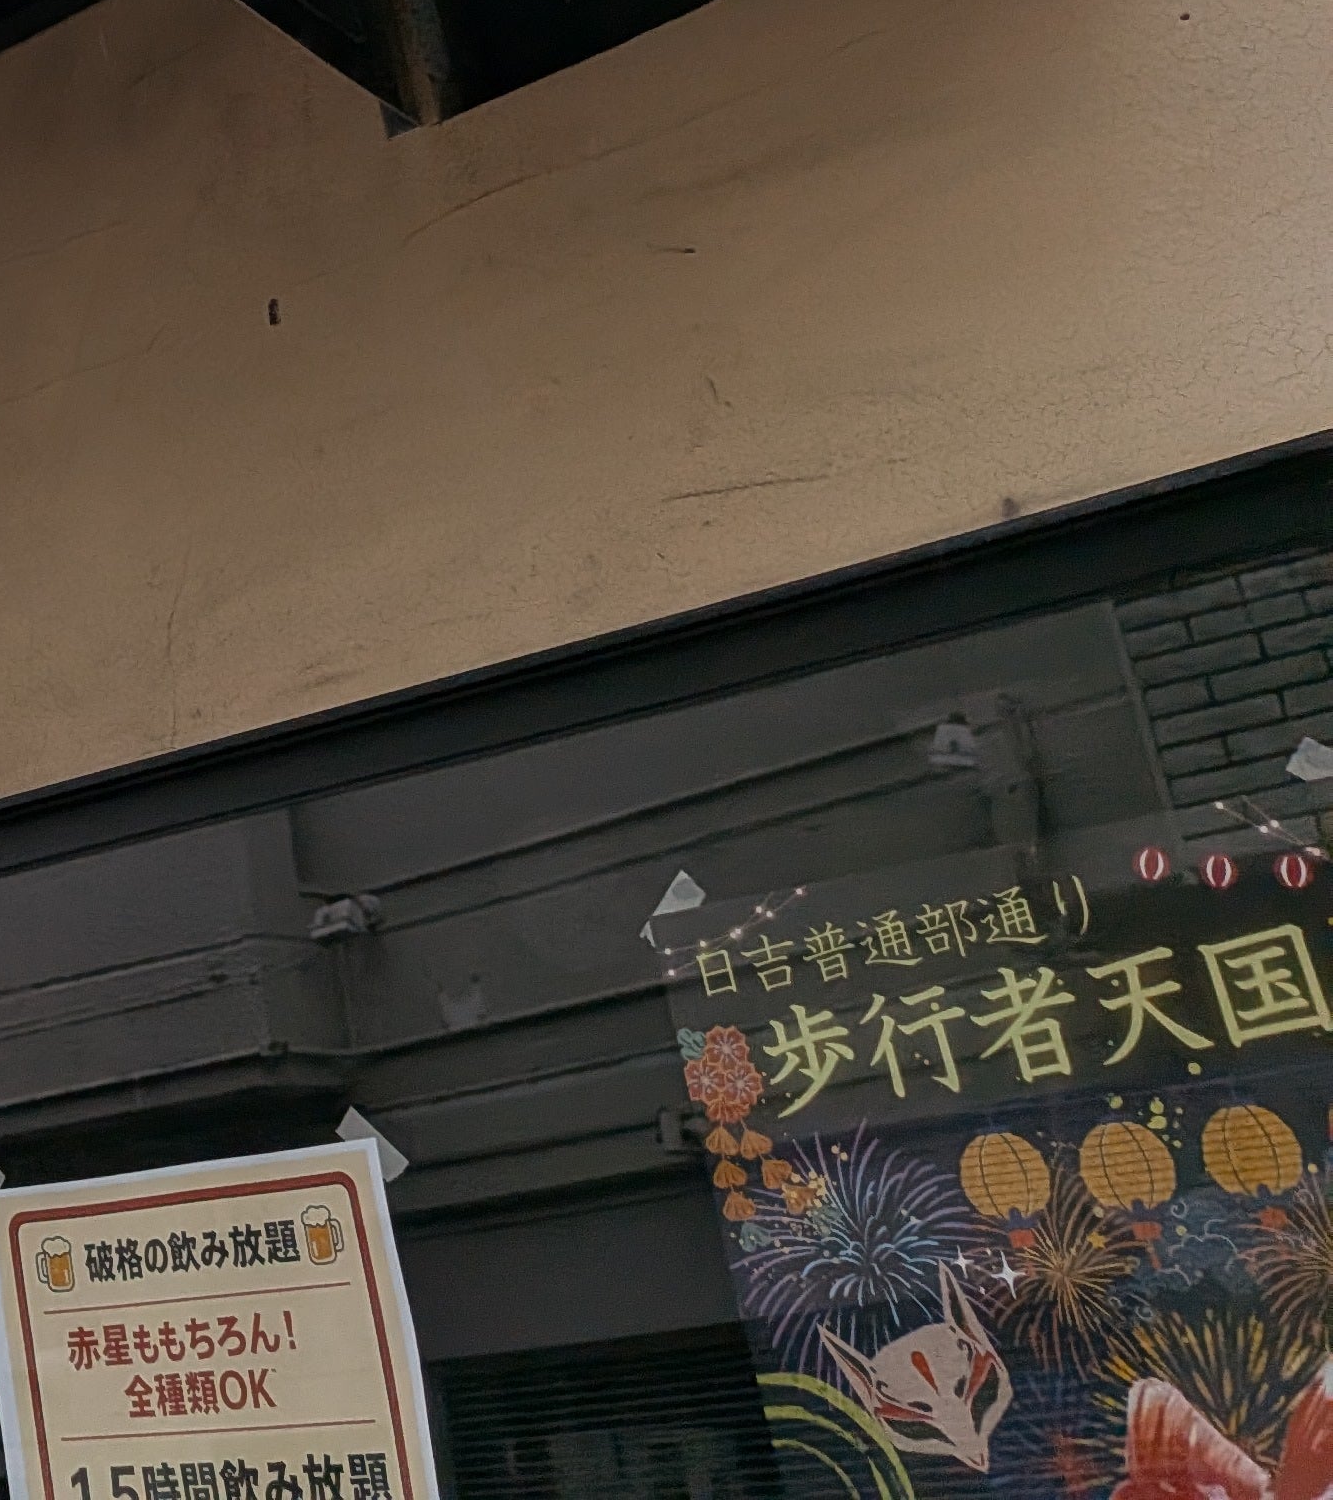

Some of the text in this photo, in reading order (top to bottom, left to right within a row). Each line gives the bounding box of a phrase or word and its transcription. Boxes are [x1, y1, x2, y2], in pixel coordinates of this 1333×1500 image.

[696, 874, 1090, 997] 日吉普通部通り
[763, 923, 1333, 1118] 歩行者天国
[84, 1219, 301, 1283] 破格の飲み放題
[67, 1310, 297, 1371] 赤星ももちろん!
[124, 1367, 277, 1418] 全種類OK
[70, 1453, 392, 1500] 15時間飲み放題
